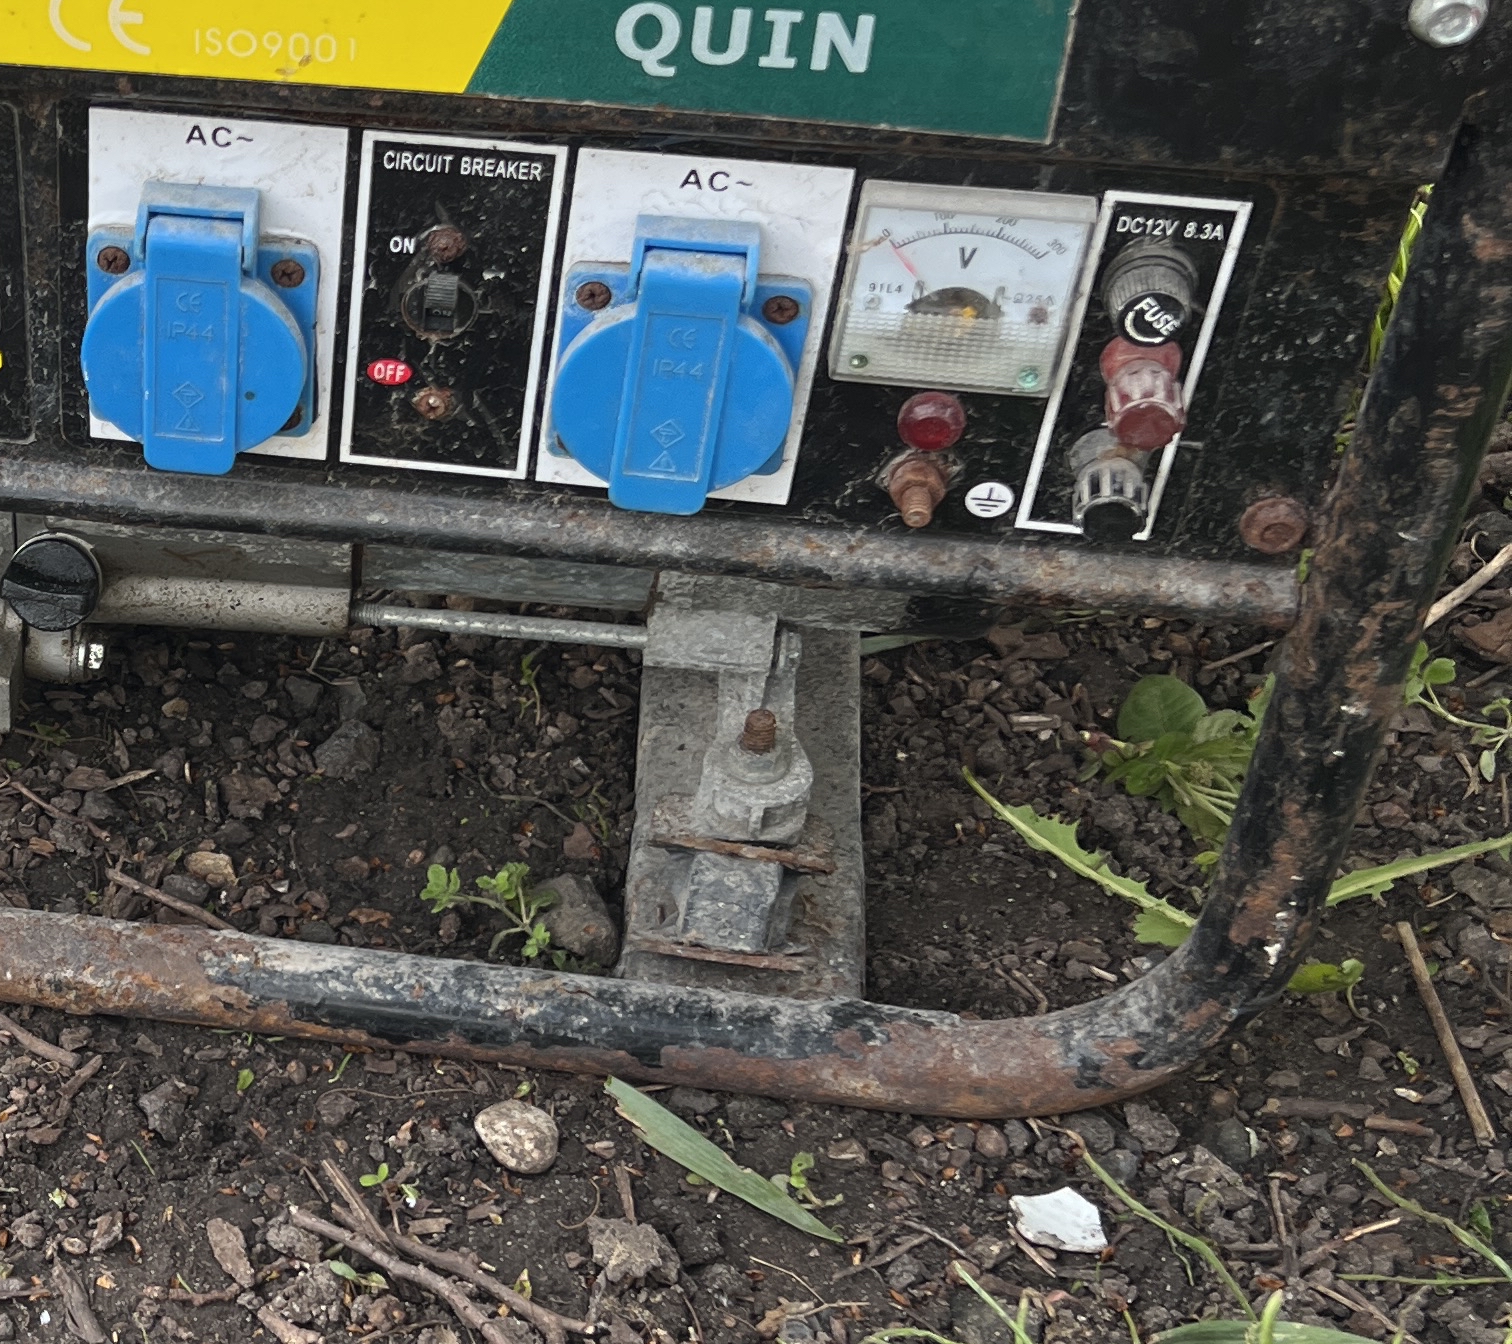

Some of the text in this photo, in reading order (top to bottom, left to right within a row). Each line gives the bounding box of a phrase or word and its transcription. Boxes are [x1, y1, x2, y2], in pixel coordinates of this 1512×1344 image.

[193, 29, 358, 64] ISO9001
[614, 1, 876, 77] QUIN
[383, 150, 544, 182] CIRCUIT BREAKER
[1116, 215, 1225, 241] DC12V 8.3A
[390, 235, 416, 255] ON
[1046, 238, 1067, 256] 300
[959, 247, 978, 269] V
[1133, 296, 1181, 336] FUSE
[168, 321, 215, 342] IP44
[373, 363, 407, 383] OFF
[653, 358, 704, 380] IP44
